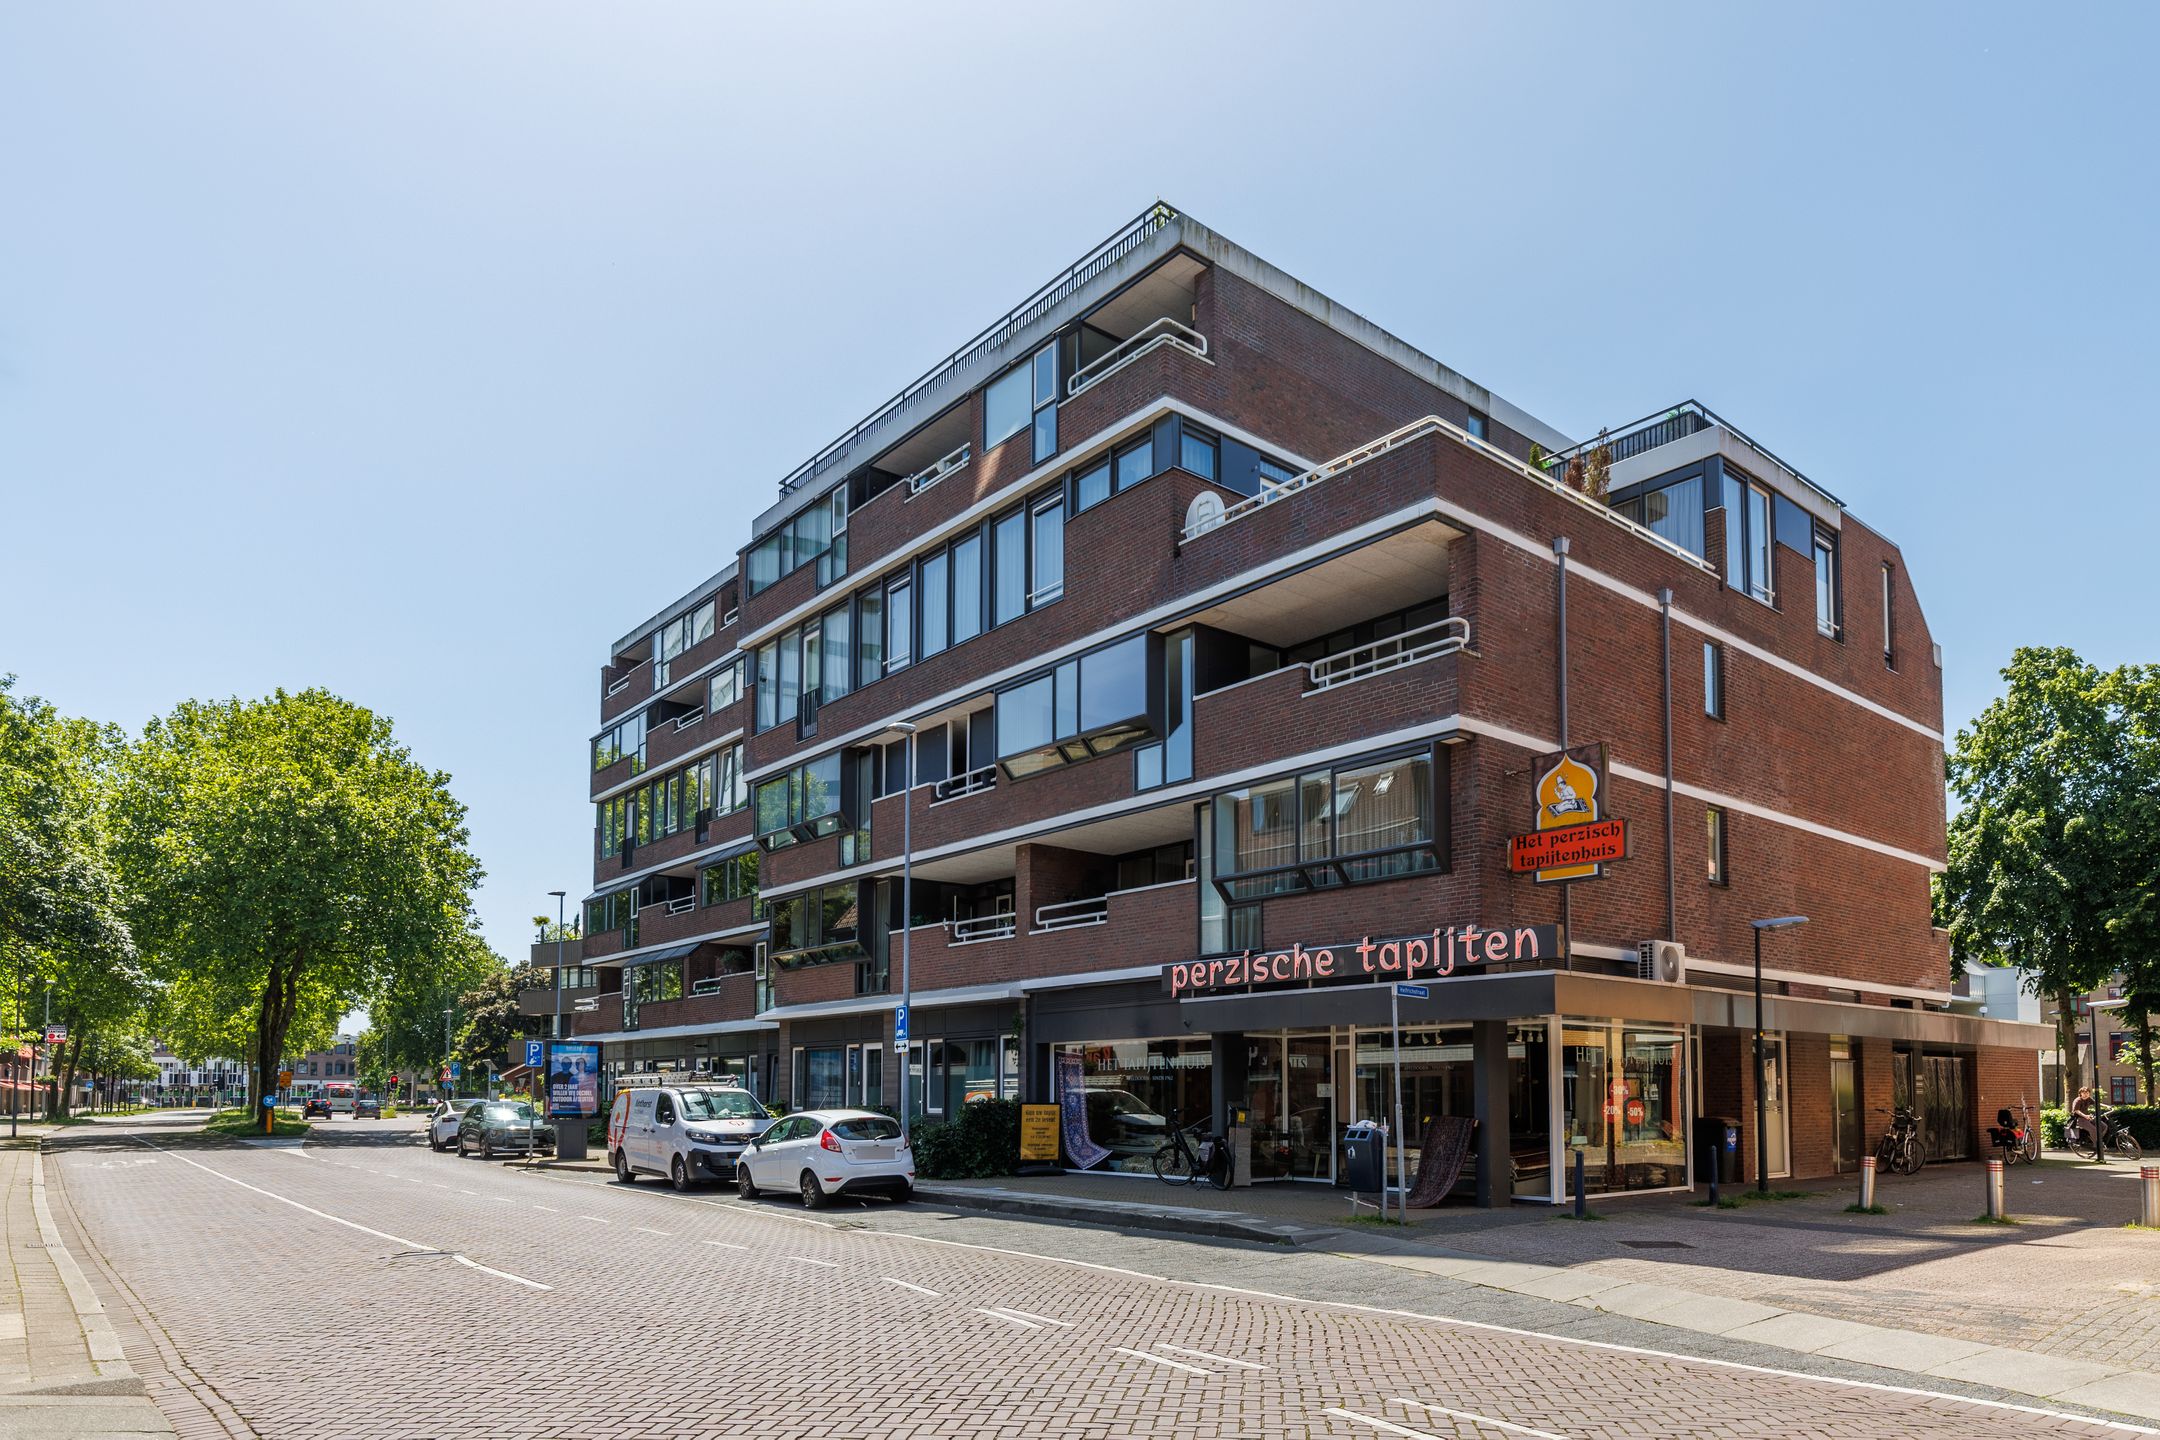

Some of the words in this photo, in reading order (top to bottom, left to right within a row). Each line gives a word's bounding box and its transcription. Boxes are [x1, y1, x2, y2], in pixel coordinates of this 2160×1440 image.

[1515, 834, 1543, 850] Het
[1550, 822, 1620, 849] perzisch
[1520, 843, 1617, 868] tapijtenhuis
[1172, 942, 1335, 998] perzische
[1355, 924, 1539, 980] tapijten
[898, 1008, 905, 1026] P
[530, 1044, 540, 1056] P
[1097, 1058, 1119, 1071] HET
[1124, 1055, 1207, 1074] TAPIJTENHUIS
[1627, 1107, 1644, 1117] -50%
